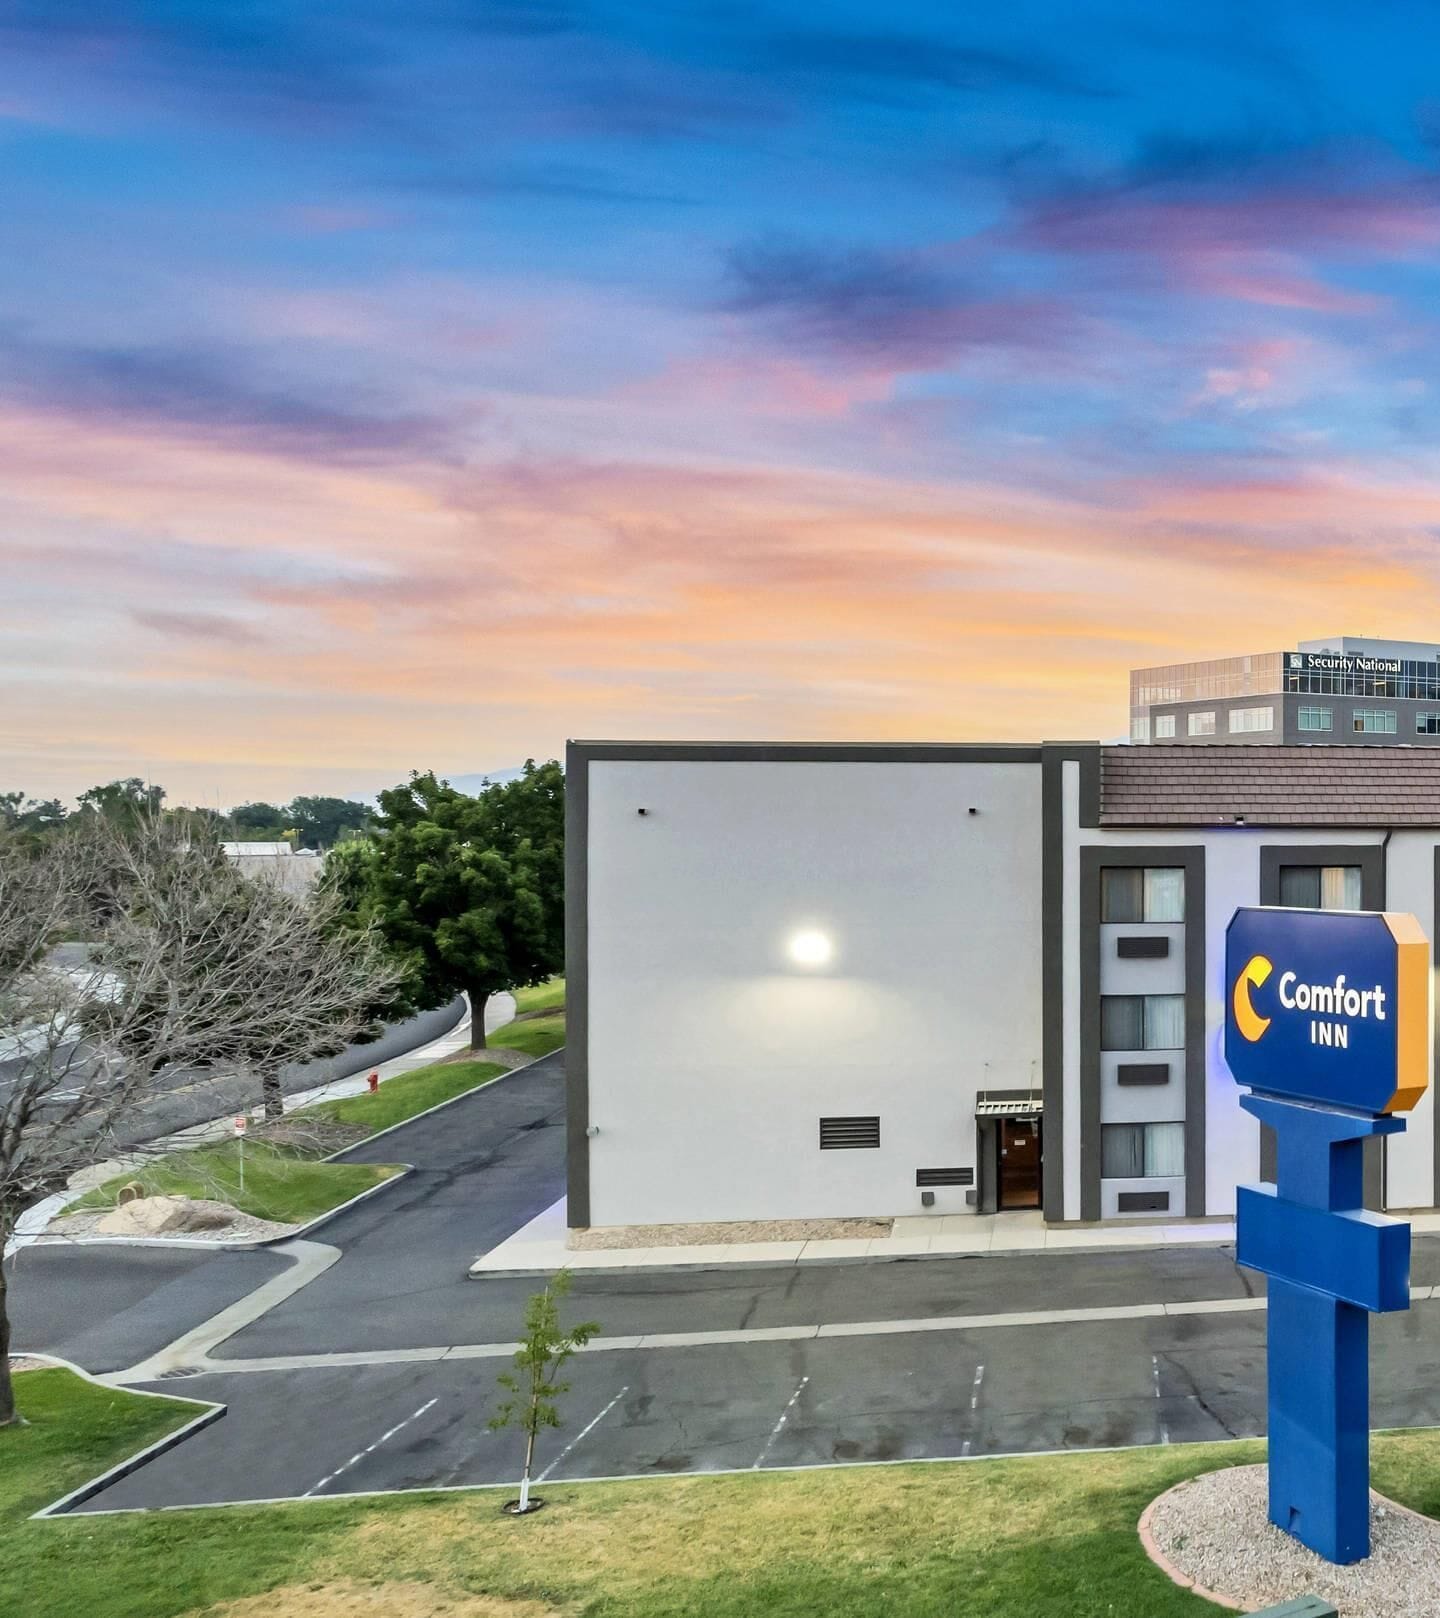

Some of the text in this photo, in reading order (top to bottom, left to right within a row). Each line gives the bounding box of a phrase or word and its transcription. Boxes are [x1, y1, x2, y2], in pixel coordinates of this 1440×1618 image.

[1308, 655, 1400, 672] Security National
[1279, 971, 1386, 1020] Comfort
[1311, 1021, 1348, 1048] INN
